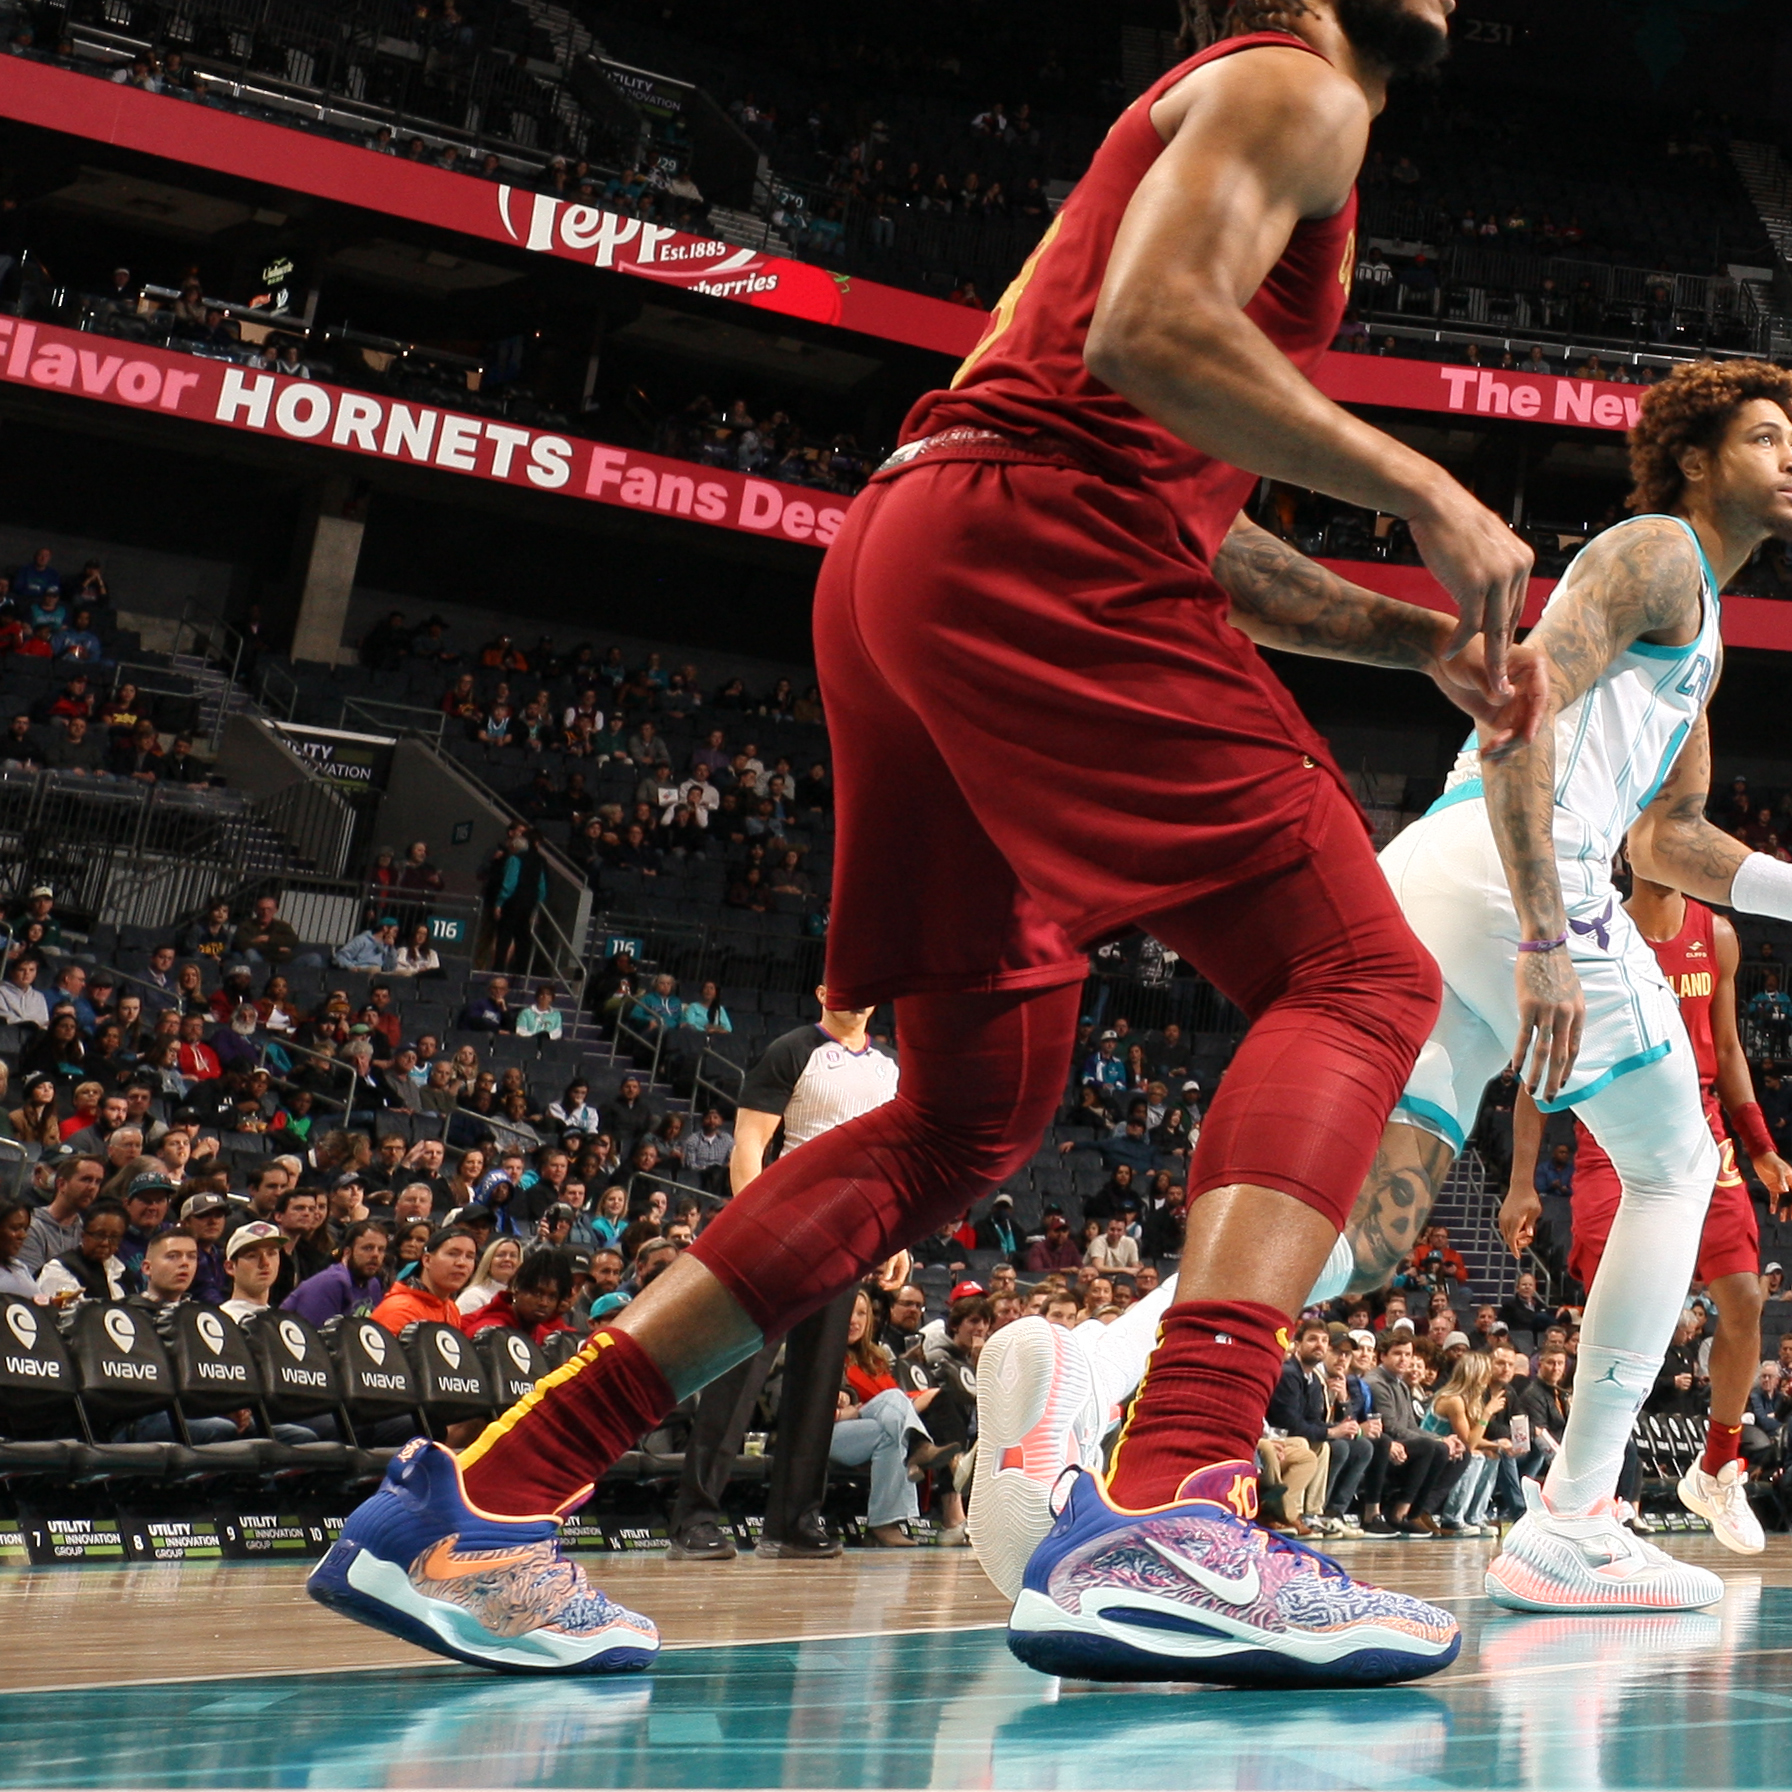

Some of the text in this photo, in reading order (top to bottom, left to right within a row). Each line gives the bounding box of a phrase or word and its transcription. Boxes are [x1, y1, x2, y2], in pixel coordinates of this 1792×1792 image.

[1464, 19, 1514, 46] 231
[659, 241, 726, 262] Est.1885
[1440, 369, 1541, 417] The
[215, 367, 573, 489] HORNETS
[585, 446, 729, 522] Fans
[433, 920, 458, 939] 116
[5, 1356, 60, 1378] wave
[101, 1360, 158, 1380] wave
[197, 1363, 247, 1381] wave
[281, 1367, 327, 1387] wave
[361, 1372, 406, 1390] wave
[438, 1377, 480, 1394] wave
[47, 1520, 94, 1533] UTILITY
[147, 1523, 192, 1536] UTILITY
[240, 1515, 278, 1528] UTILITY
[33, 1531, 42, 1548] 7
[64, 1533, 122, 1546] INNOVATION
[165, 1535, 220, 1548] INNOVATION
[227, 1526, 236, 1541] 9
[254, 1527, 305, 1539] INNOVATION
[309, 1527, 323, 1542] 10
[133, 1535, 144, 1550] 8
[54, 1546, 84, 1557] GROUP
[155, 1548, 184, 1559] GROUP
